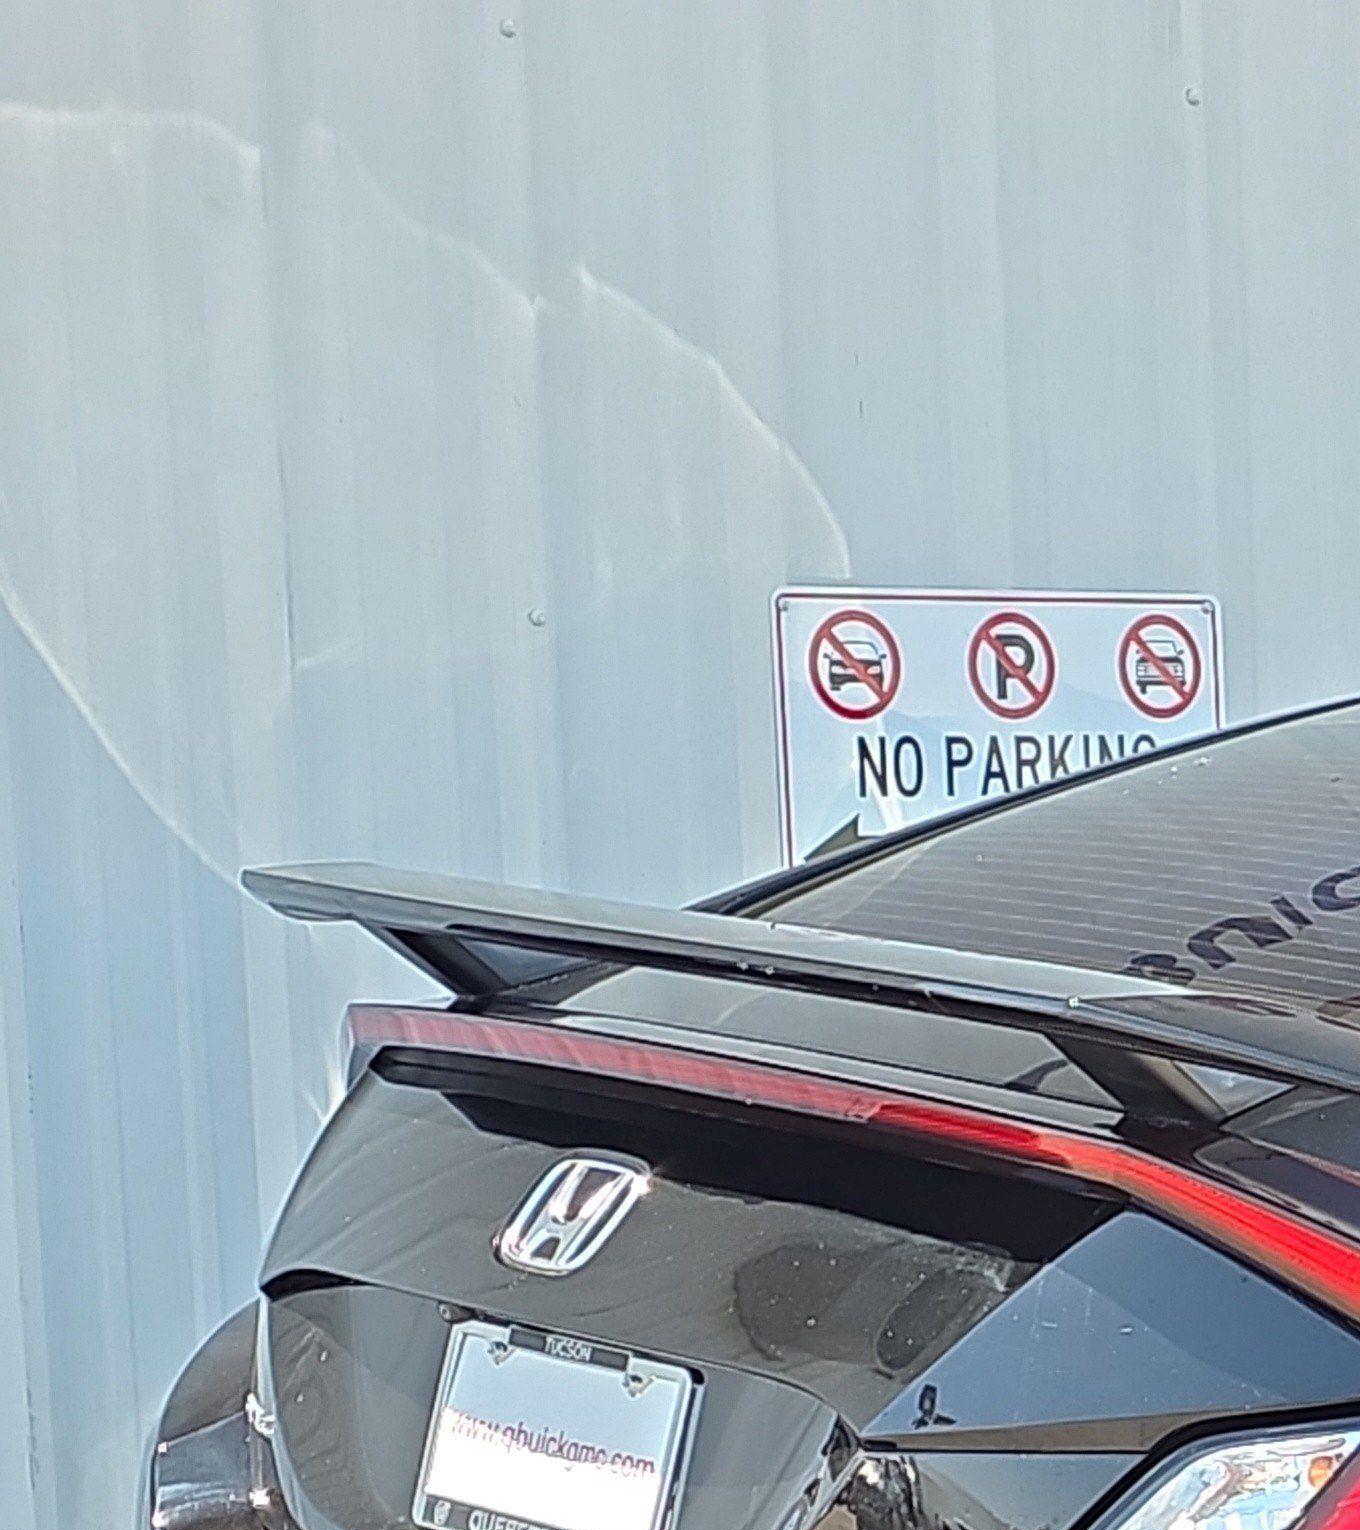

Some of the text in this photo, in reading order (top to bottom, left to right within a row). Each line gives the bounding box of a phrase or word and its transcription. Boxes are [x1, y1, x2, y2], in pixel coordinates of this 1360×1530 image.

[857, 733, 1157, 798] NO PARKI
[545, 1336, 592, 1362] TUCSON
